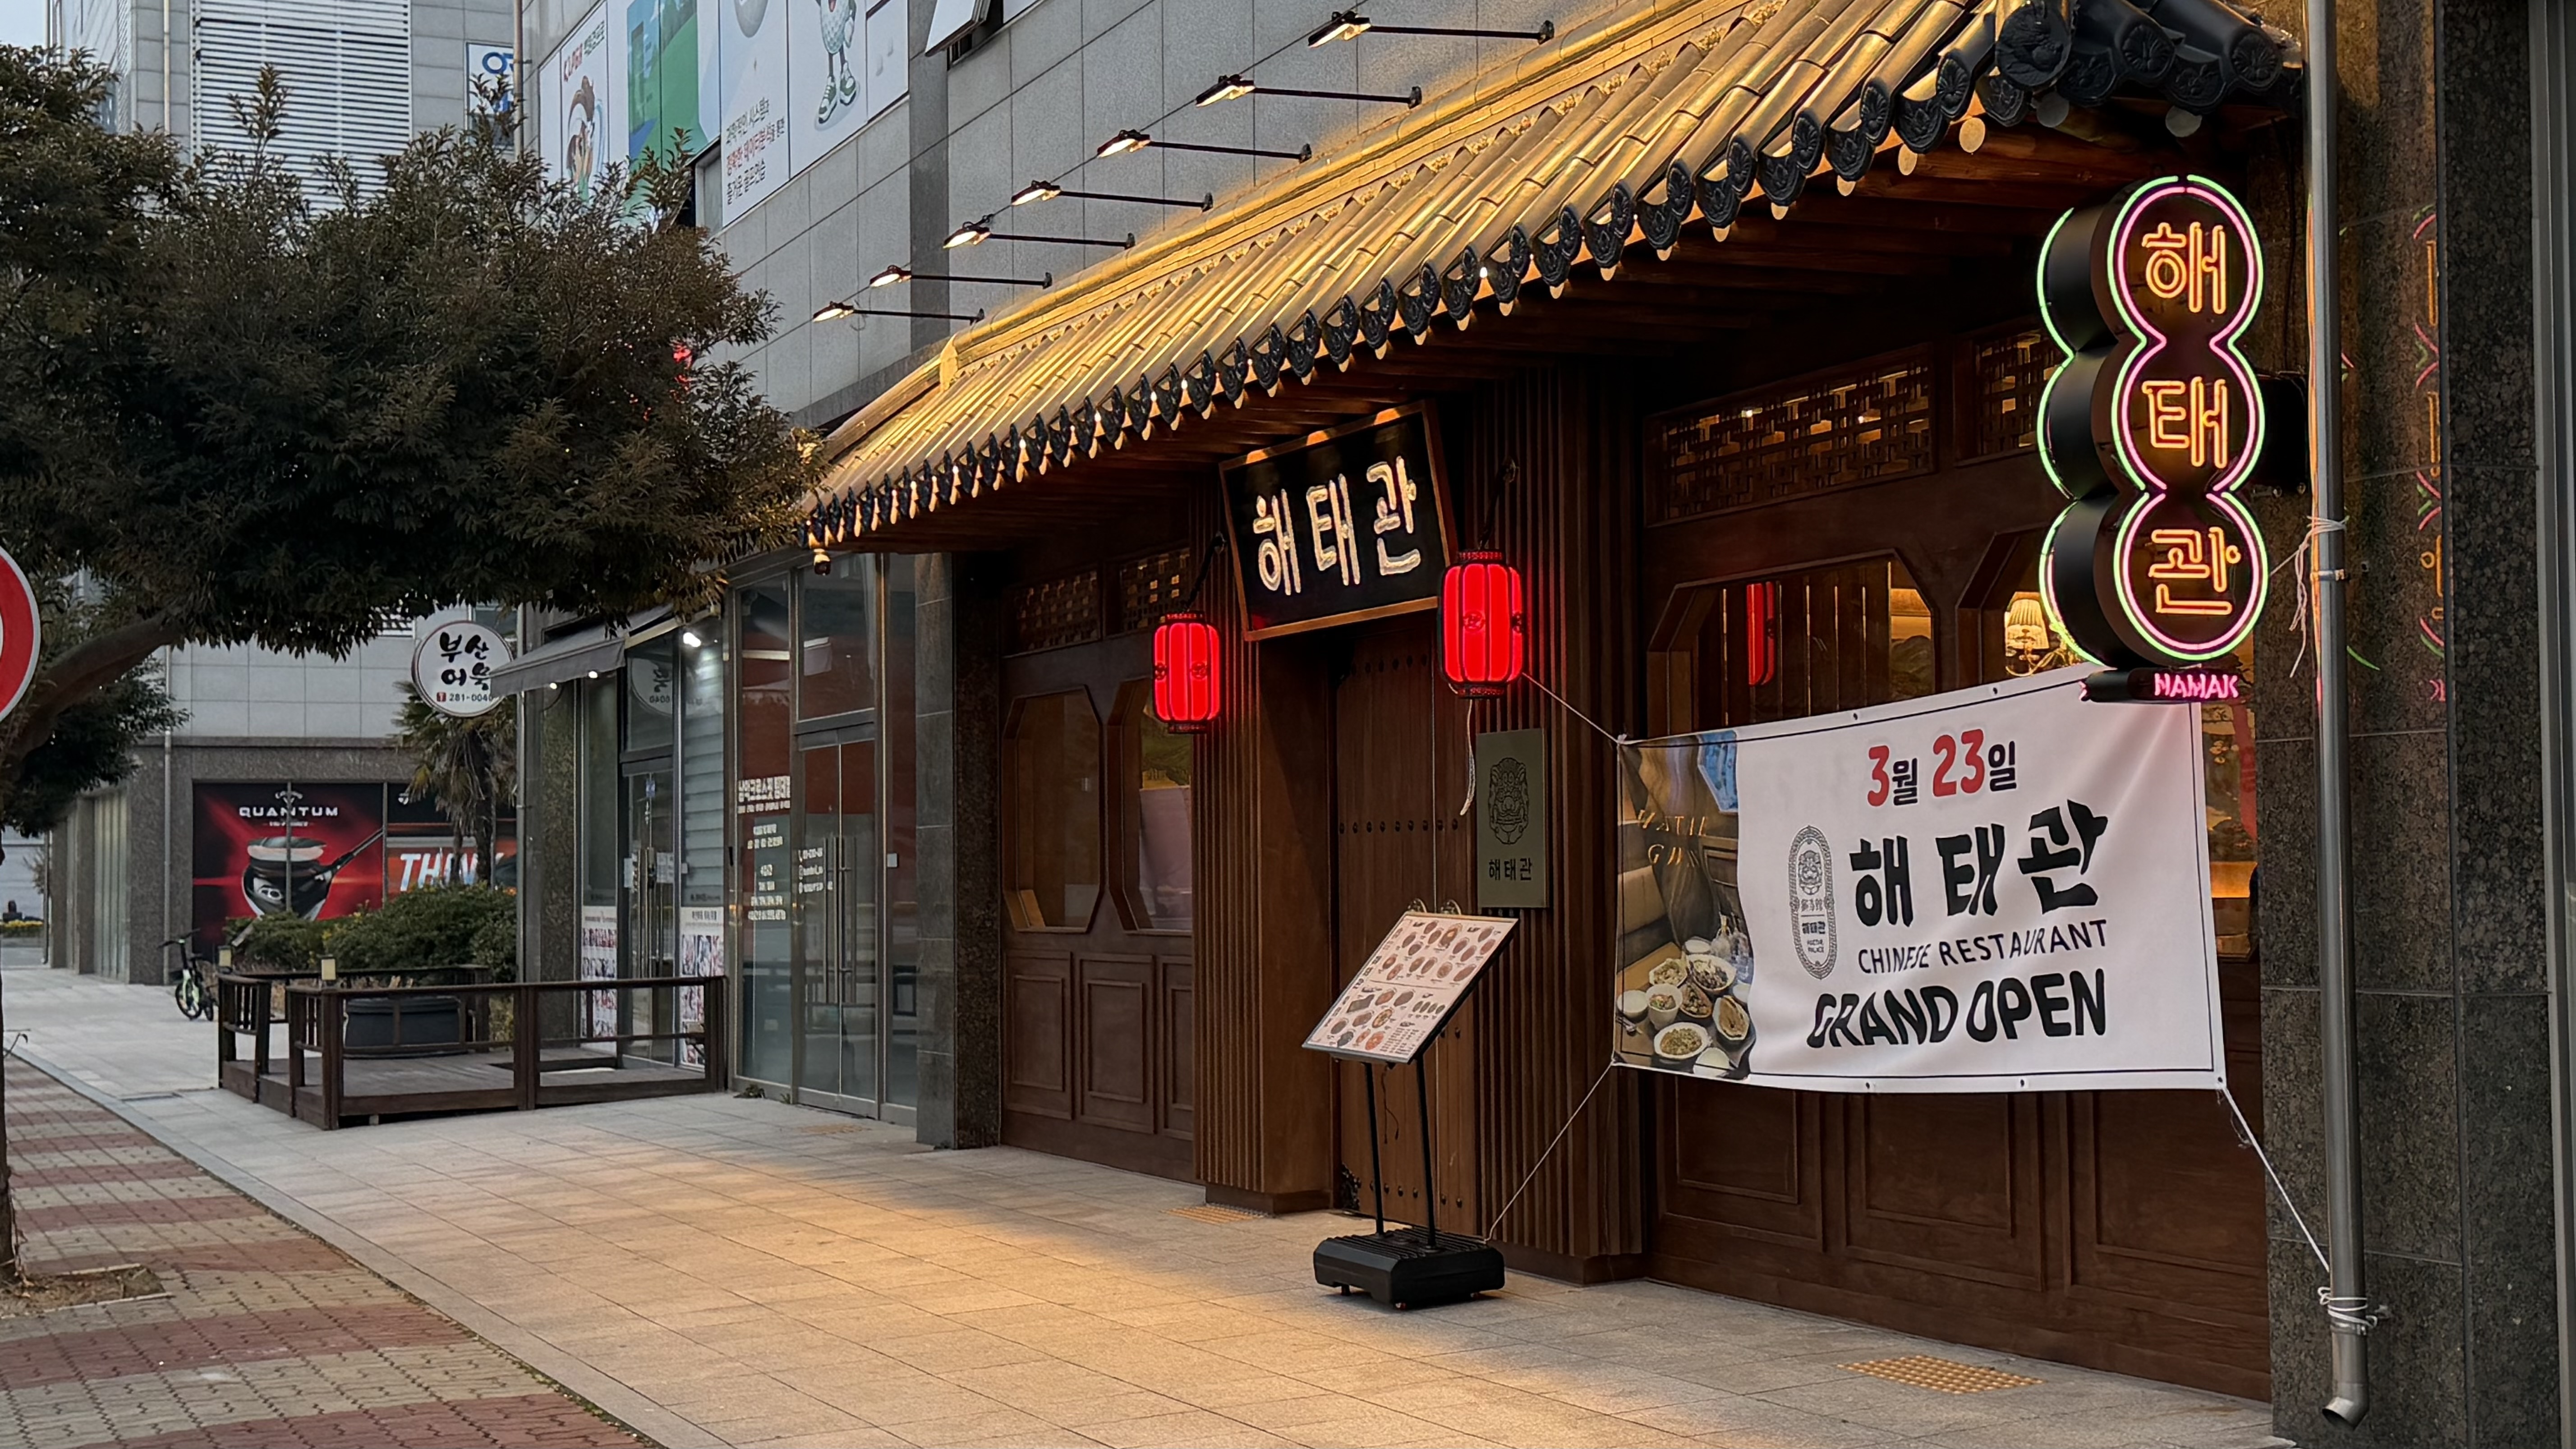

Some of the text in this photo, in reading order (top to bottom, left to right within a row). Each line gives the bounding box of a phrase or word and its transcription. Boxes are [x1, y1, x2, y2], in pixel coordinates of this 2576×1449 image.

[2141, 221, 2241, 616] 해태관
[1252, 454, 1421, 596] 해태관
[440, 632, 489, 663] 부산
[441, 662, 491, 691] 어묵
[1867, 728, 2017, 807] 3월 23일
[239, 806, 338, 818] QUANTUM
[1489, 857, 1532, 881] 해태관
[1849, 798, 2109, 928] 해태관
[1858, 919, 2107, 974] CHINESE RESTAURANT
[1806, 968, 2106, 1049] GRAND OPEN
